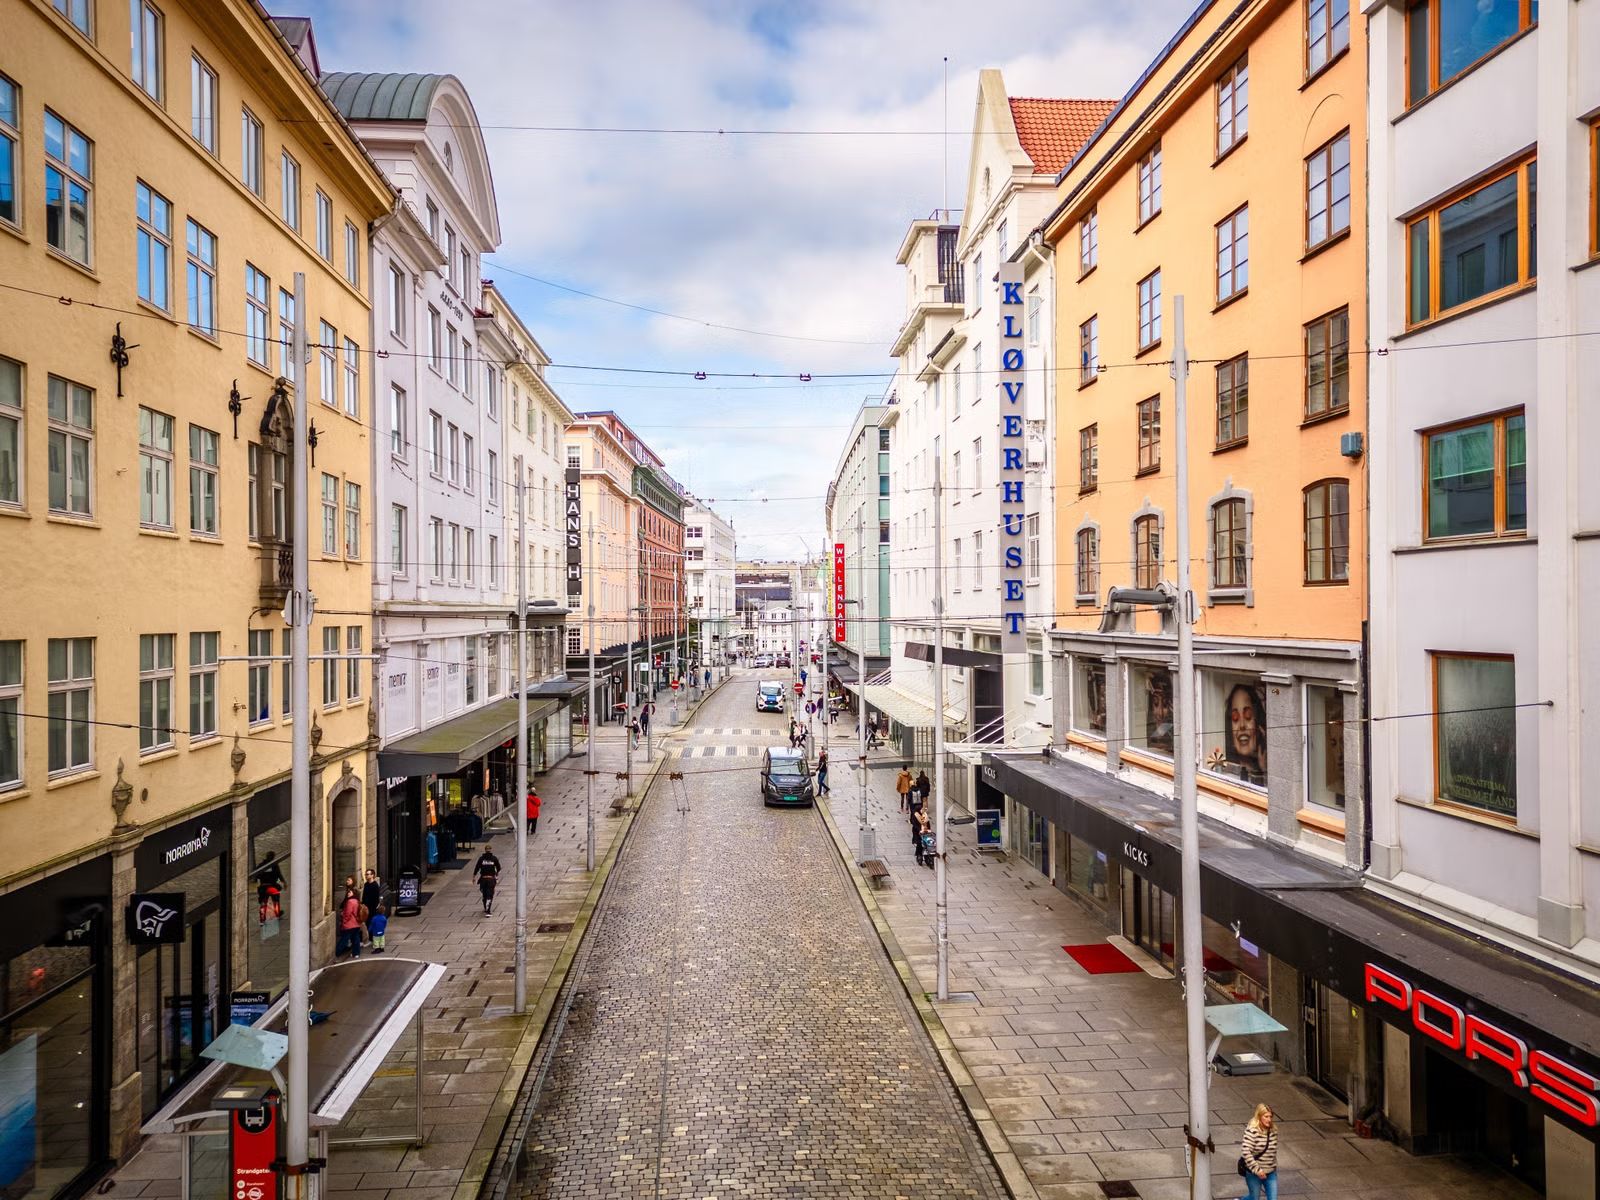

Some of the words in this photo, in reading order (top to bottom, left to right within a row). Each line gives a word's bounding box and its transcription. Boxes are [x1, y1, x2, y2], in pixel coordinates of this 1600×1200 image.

[1002, 282, 1024, 634] KLØVERHUSET
[567, 485, 580, 546] HANS
[166, 837, 202, 865] NORRØNA
[1124, 841, 1148, 867] KICKS
[1364, 962, 1600, 1127] PORS
